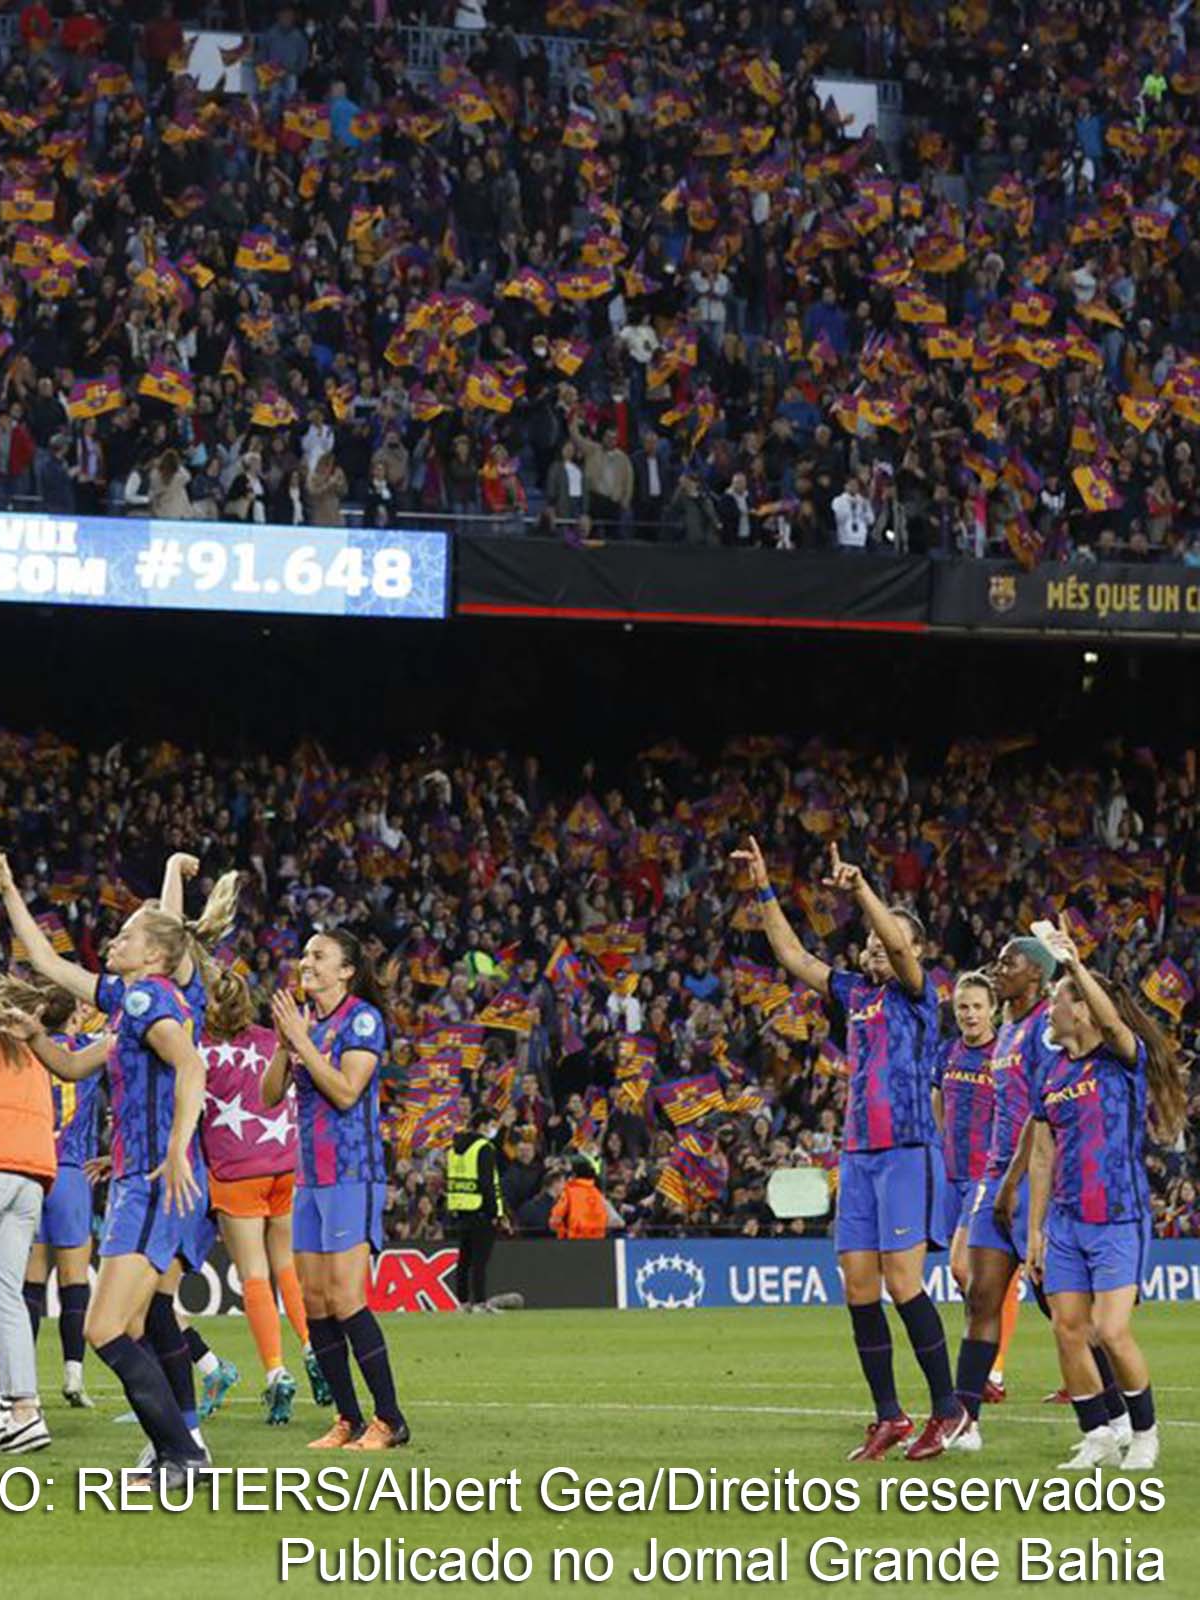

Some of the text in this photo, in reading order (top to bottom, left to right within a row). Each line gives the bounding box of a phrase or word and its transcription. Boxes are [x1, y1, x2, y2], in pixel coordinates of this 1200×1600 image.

[135, 537, 414, 599] #91.648
[1047, 573, 1090, 611] MÉS
[1095, 583, 1142, 617] QUE
[1147, 584, 1180, 612] UN
[729, 1265, 828, 1304] UEFA
